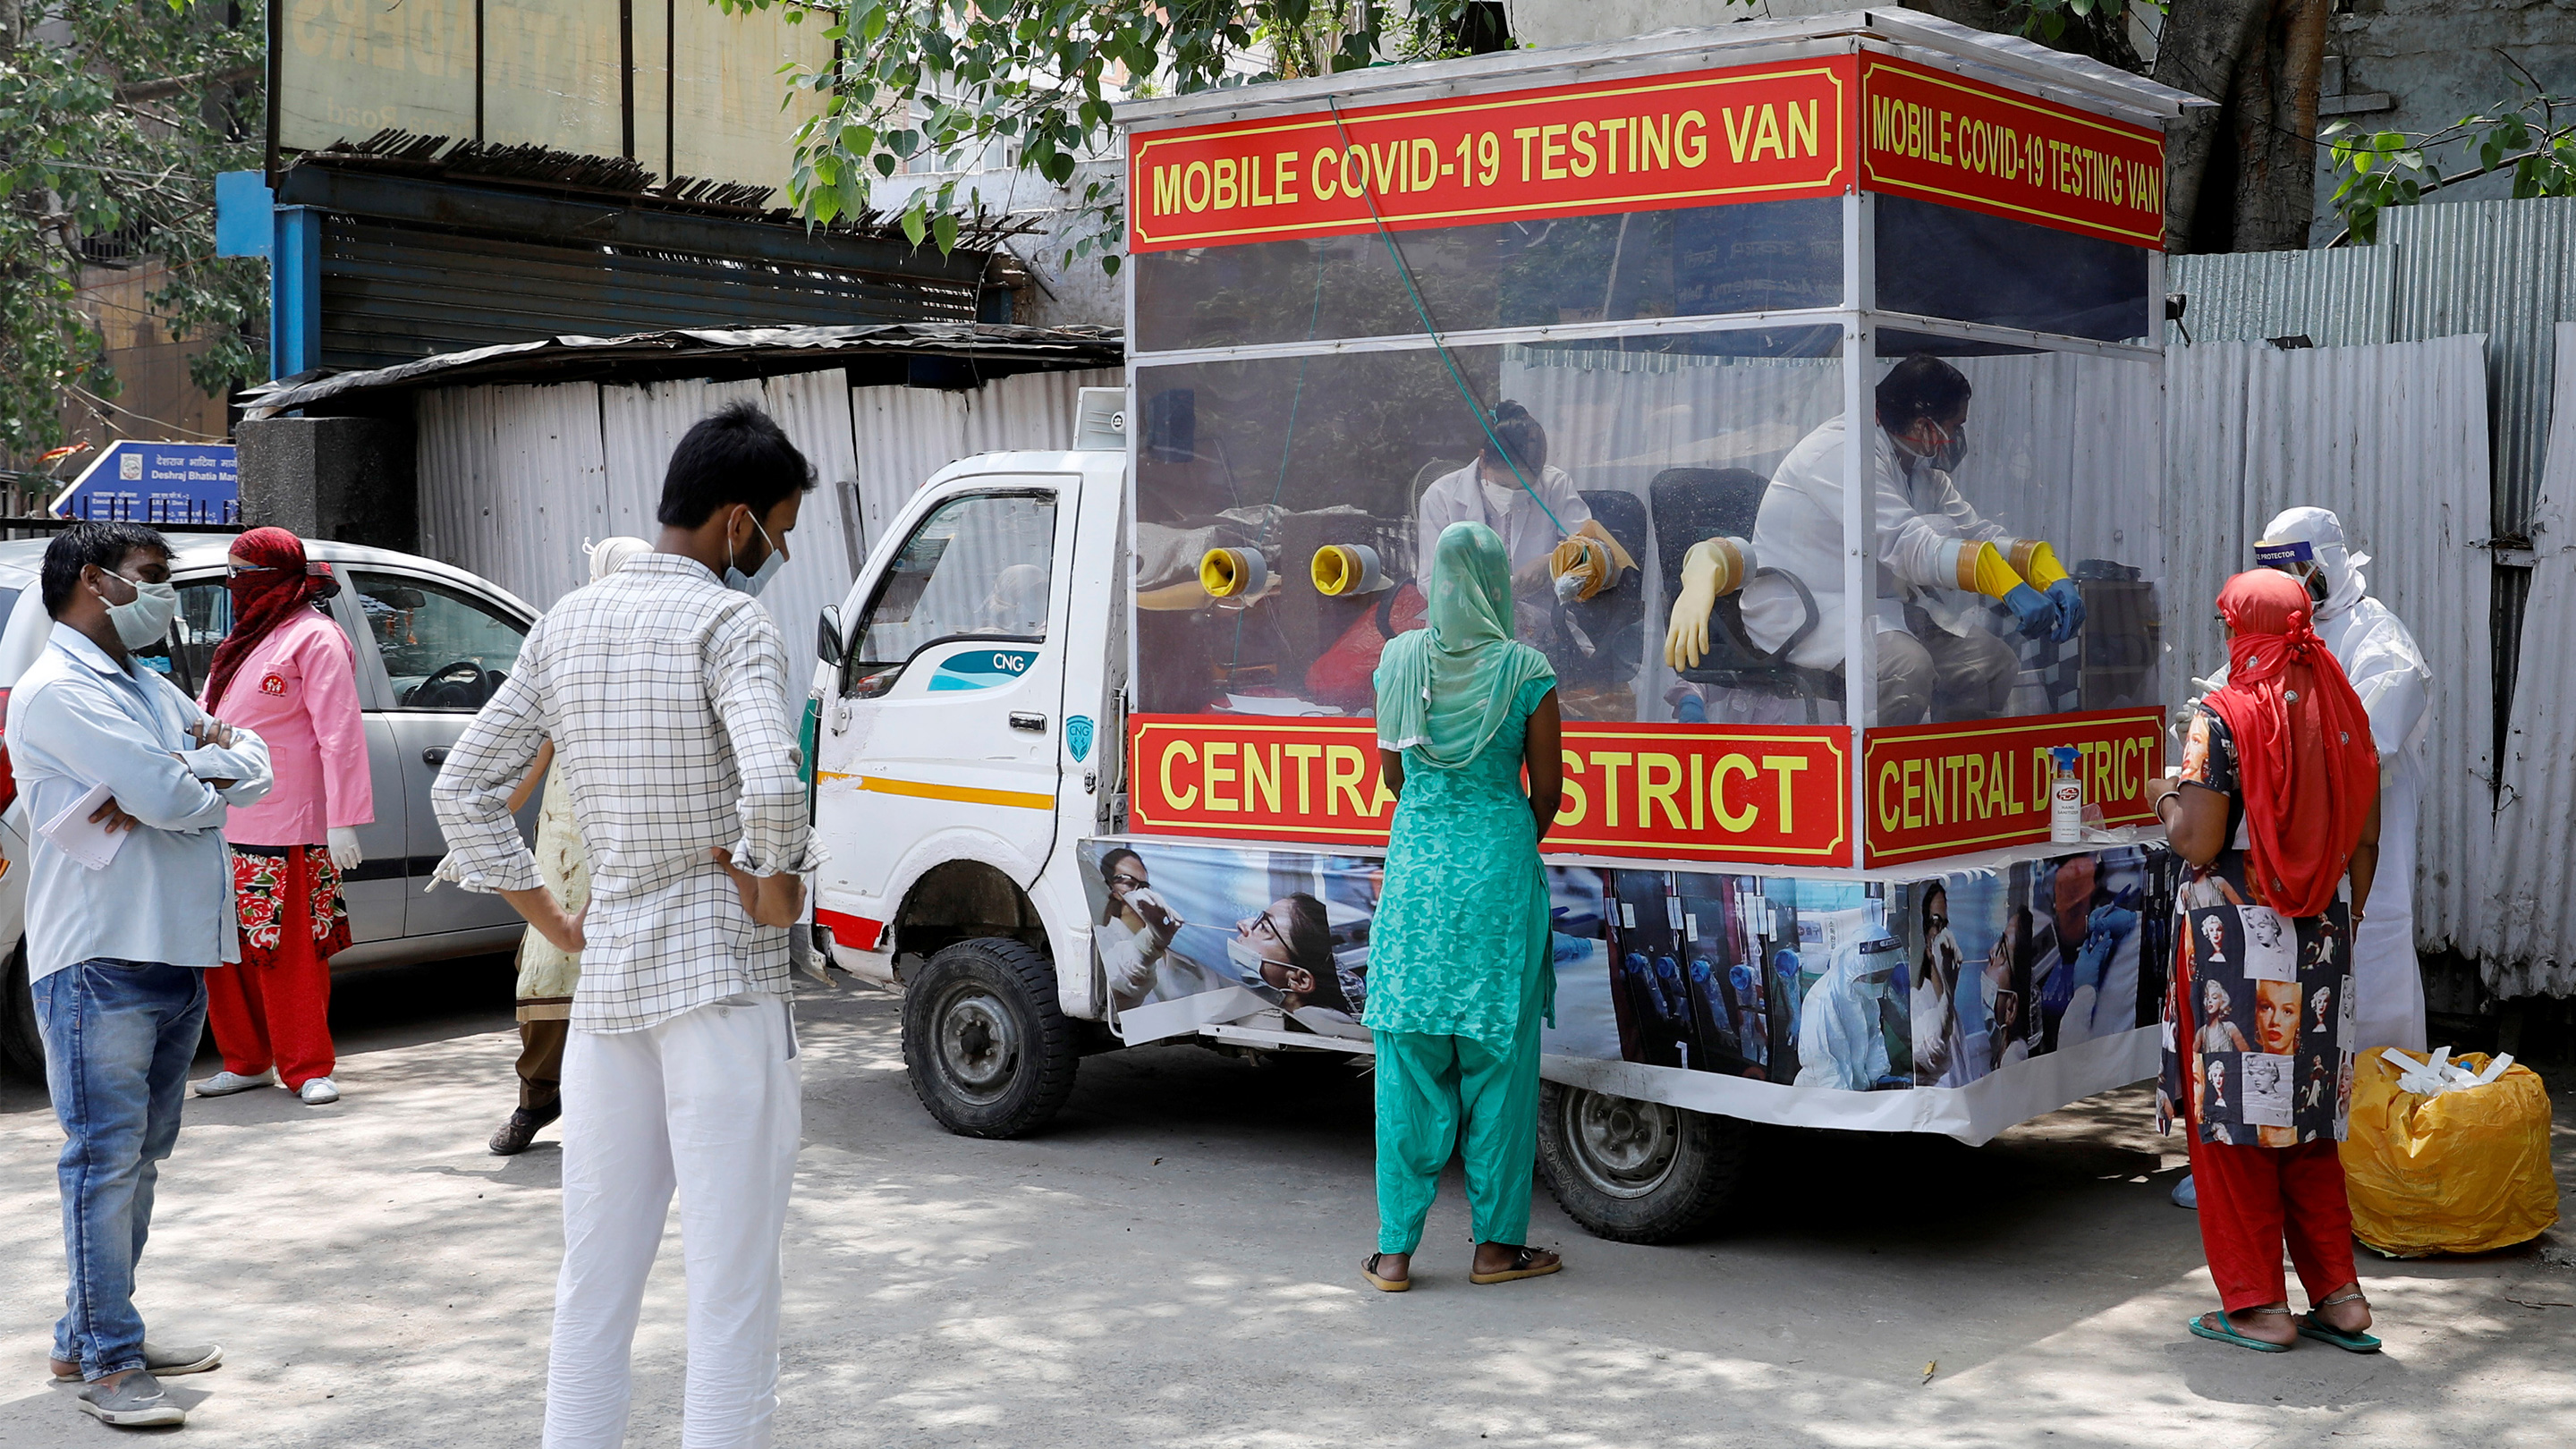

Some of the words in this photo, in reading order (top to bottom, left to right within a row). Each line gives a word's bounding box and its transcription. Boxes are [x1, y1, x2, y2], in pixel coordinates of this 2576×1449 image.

[1153, 151, 1299, 216] MOBILE
[1311, 131, 1500, 201] COVID-19
[1513, 109, 1707, 182] TESTING
[1722, 98, 1818, 164] VAN
[1872, 94, 1953, 165] MOBILE
[1959, 115, 2044, 188] COVID-19
[2048, 139, 2123, 206] TESTING
[2126, 159, 2159, 215] VAN
[156, 453, 185, 467] देशराज
[189, 455, 216, 468] भाटिया
[151, 470, 187, 482] Deshraj
[188, 470, 217, 481] Bhatia
[2260, 550, 2296, 561] PROTECTOR
[993, 653, 1025, 672] CNG
[1069, 725, 1090, 737] CNG
[1526, 749, 1809, 834] STRICT
[1878, 750, 2024, 833] CENTRAL
[2033, 736, 2155, 812] DTRICT
